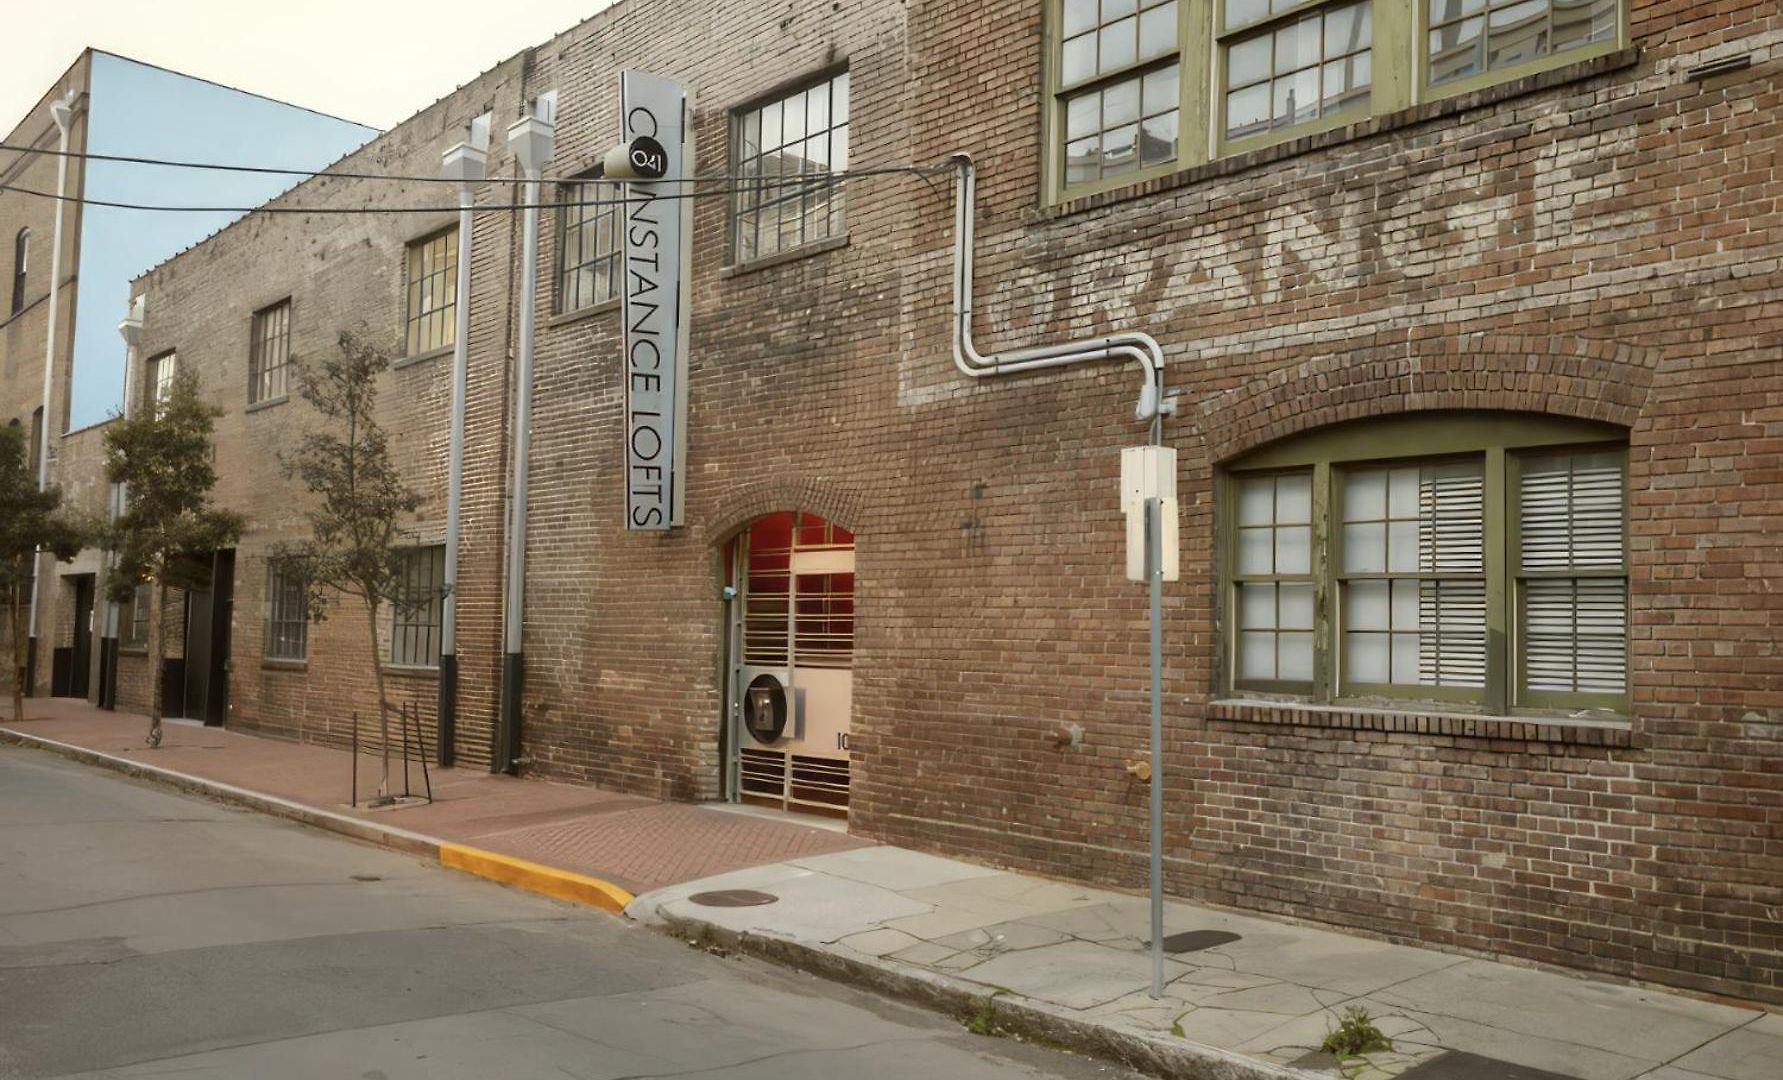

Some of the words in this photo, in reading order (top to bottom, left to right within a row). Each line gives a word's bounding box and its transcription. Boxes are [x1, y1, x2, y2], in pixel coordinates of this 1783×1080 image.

[628, 106, 661, 392] CNSTANCE
[986, 124, 1656, 346] ORANGE
[631, 411, 663, 527] LOFTS
